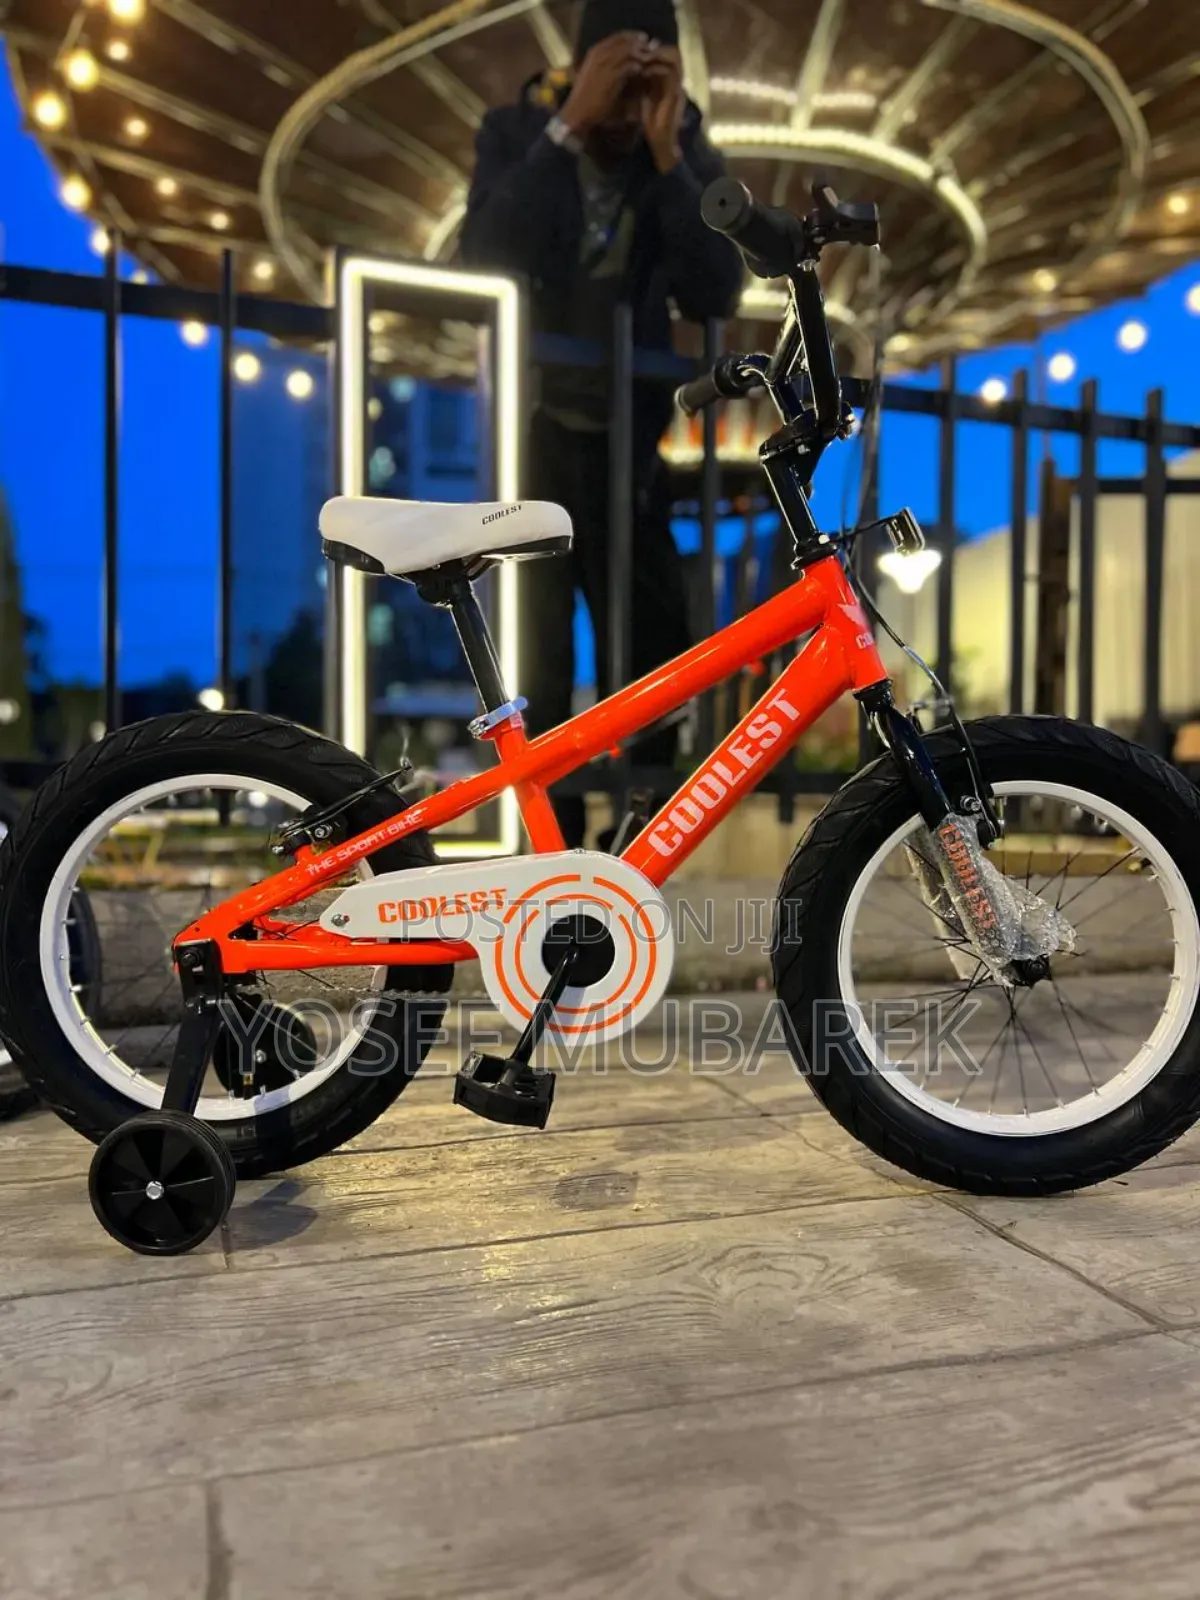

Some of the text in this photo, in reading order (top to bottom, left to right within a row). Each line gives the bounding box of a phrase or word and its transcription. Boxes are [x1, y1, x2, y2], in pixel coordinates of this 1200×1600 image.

[482, 504, 522, 525] COOLEST
[648, 688, 800, 857] COOLEST
[306, 809, 425, 876] THE SPORT BIKE
[378, 888, 508, 924] COOLEST
